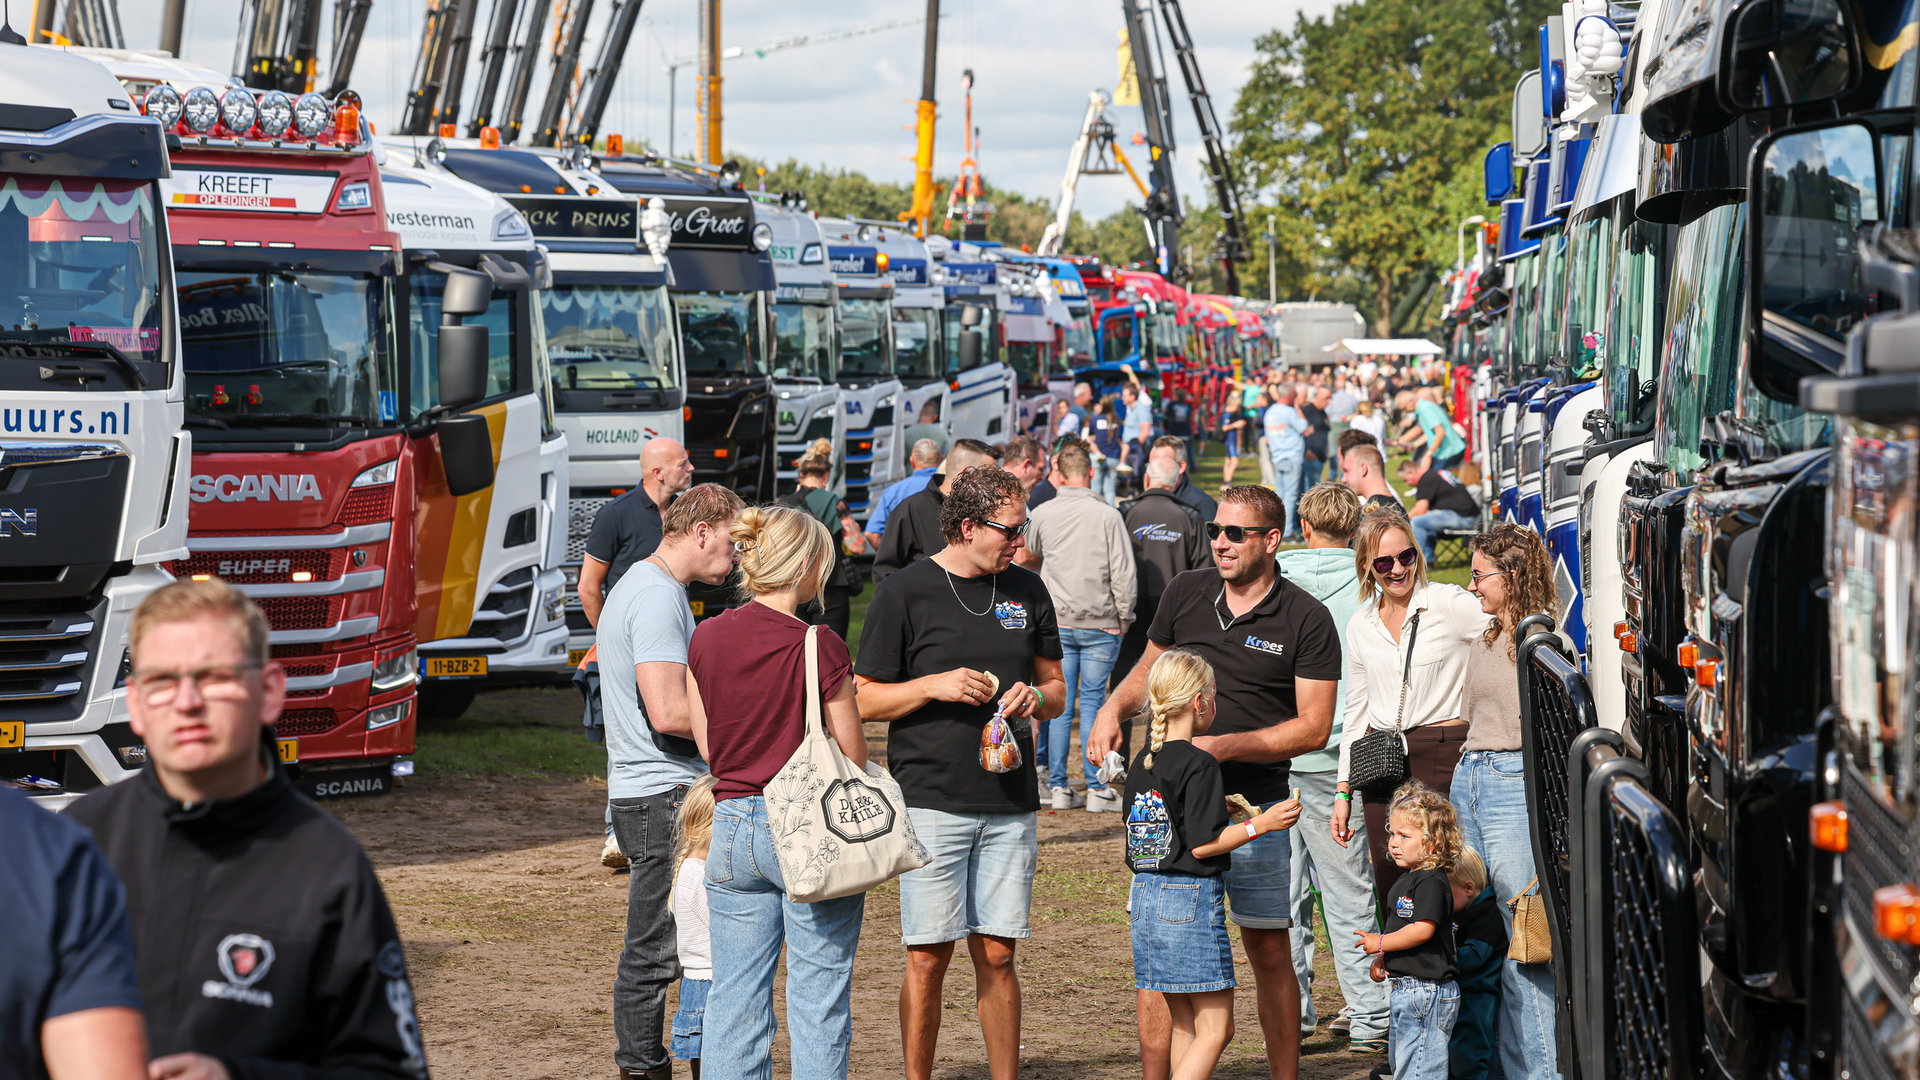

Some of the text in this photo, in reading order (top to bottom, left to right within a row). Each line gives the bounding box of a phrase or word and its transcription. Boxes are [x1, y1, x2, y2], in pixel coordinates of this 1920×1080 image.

[199, 174, 272, 194] KREEFT
[200, 194, 271, 207] OPLEIDINGEN
[571, 210, 631, 227] PRINS
[686, 206, 745, 238] Groot
[586, 429, 640, 444] HOLLAND
[190, 474, 323, 502] SCANIA
[218, 558, 291, 575] SUPER
[1245, 635, 1284, 652] Kroes
[432, 659, 480, 674] 11-BZB-2
[315, 778, 383, 796] SCANIA
